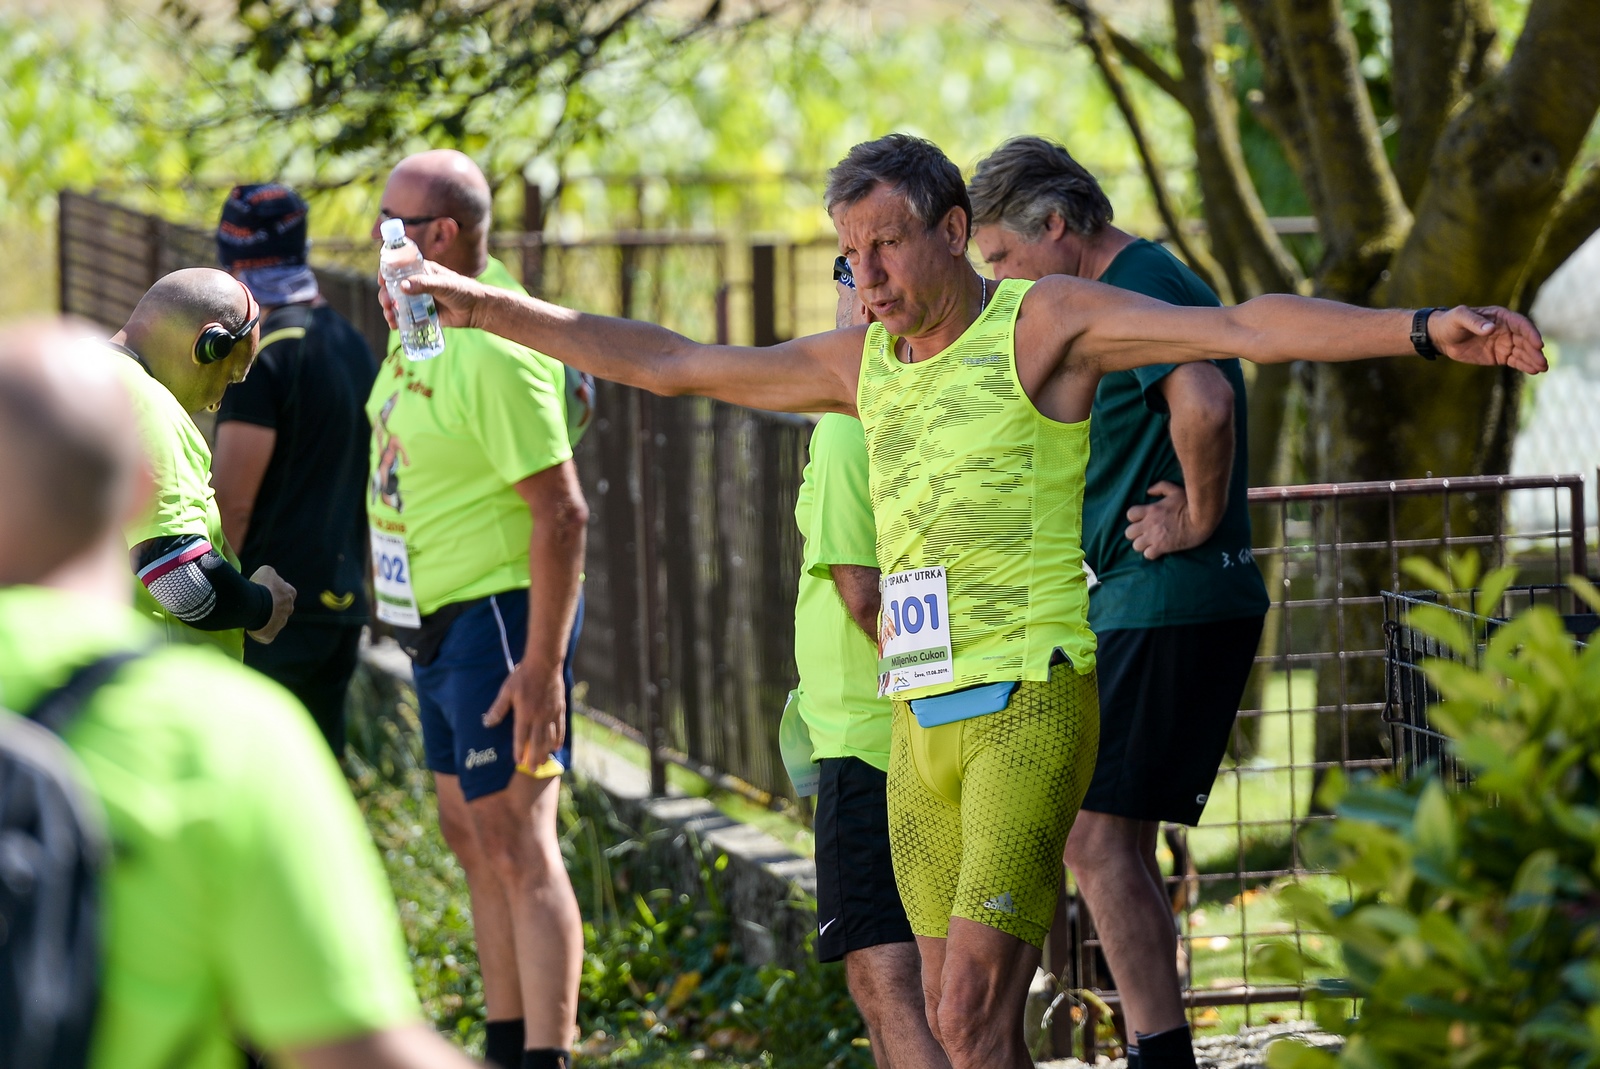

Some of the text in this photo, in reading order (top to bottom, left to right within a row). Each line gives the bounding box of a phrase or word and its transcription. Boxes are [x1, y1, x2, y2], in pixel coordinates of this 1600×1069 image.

[1222, 551, 1235, 568] 3.
[914, 569, 943, 581] UTRKA
[891, 594, 939, 636] 101
[891, 651, 945, 668] Miljenko Cukon
